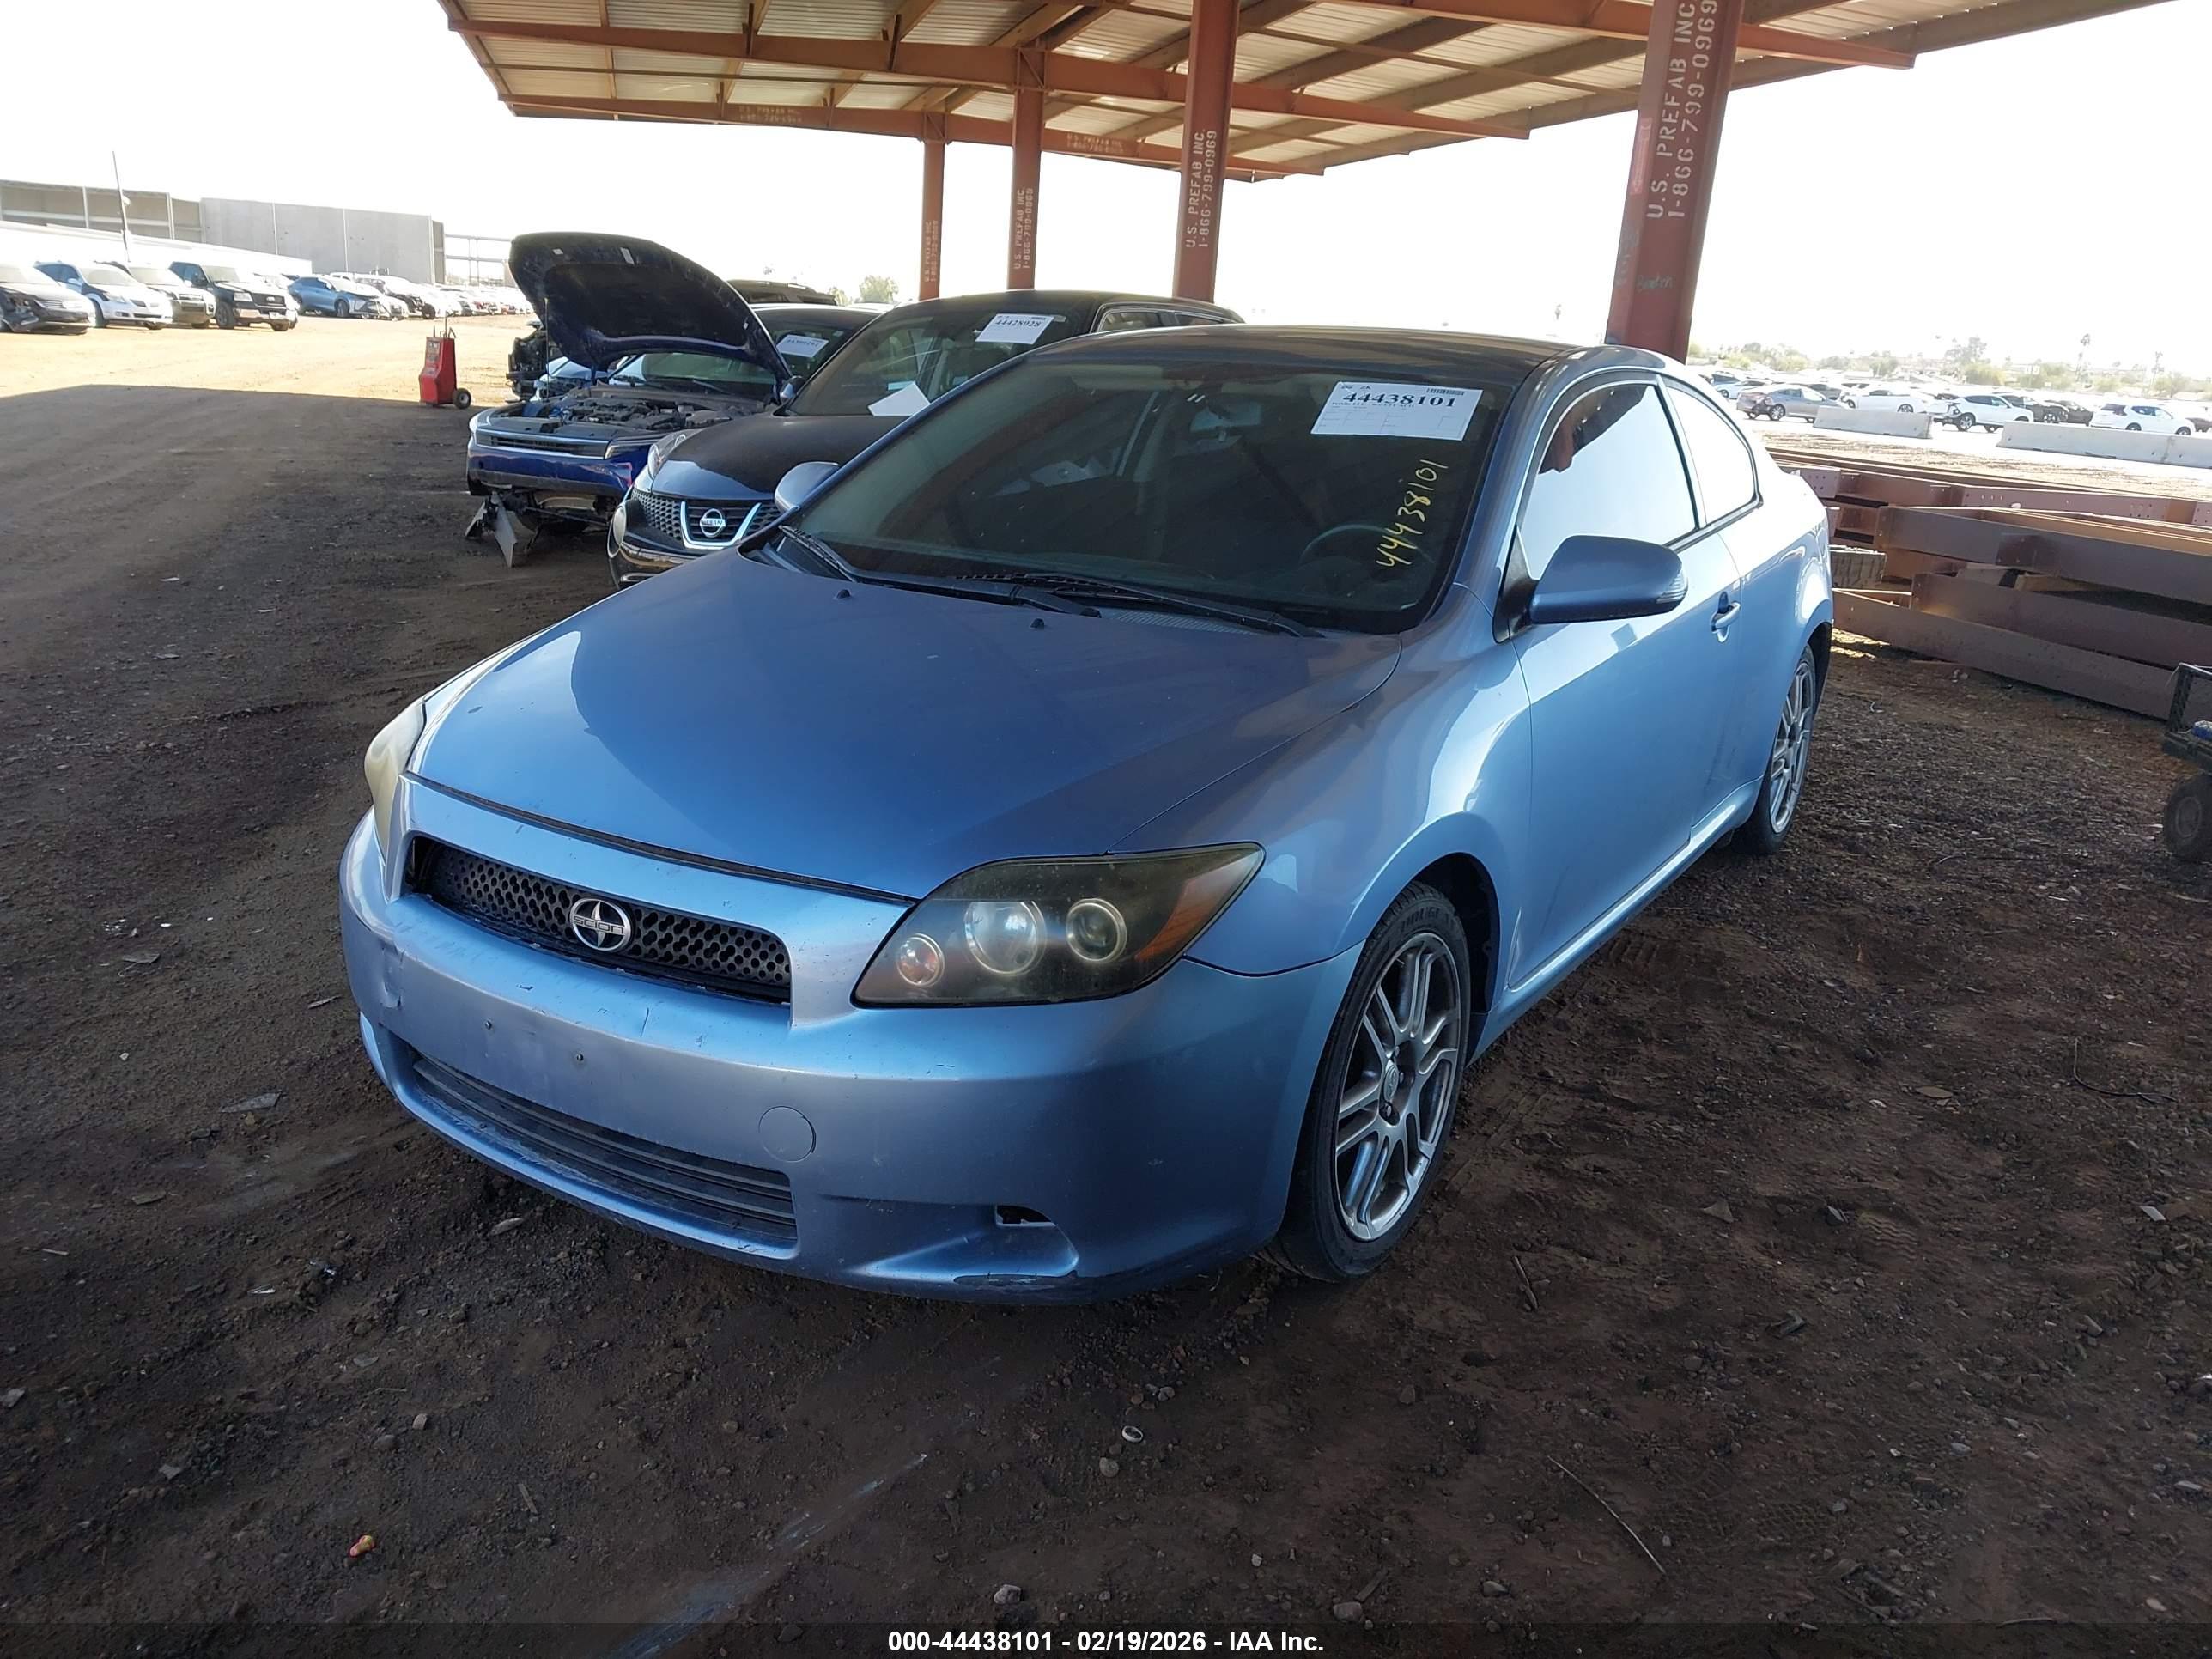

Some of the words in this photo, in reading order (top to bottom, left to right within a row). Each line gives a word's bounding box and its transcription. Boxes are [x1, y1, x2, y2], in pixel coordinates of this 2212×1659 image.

[1656, 58, 1686, 157] PREFAB
[1668, 0, 1717, 217] 1-866-799-0969
[1188, 161, 1202, 215] PREFAB
[1199, 131, 1217, 247] 1-866-799-0969
[1646, 173, 1670, 218] U.S.
[1185, 222, 1198, 247] U.S.
[1343, 392, 1455, 407] 44438101
[1376, 459, 1449, 567] 44438101
[573, 915, 624, 934] SCION
